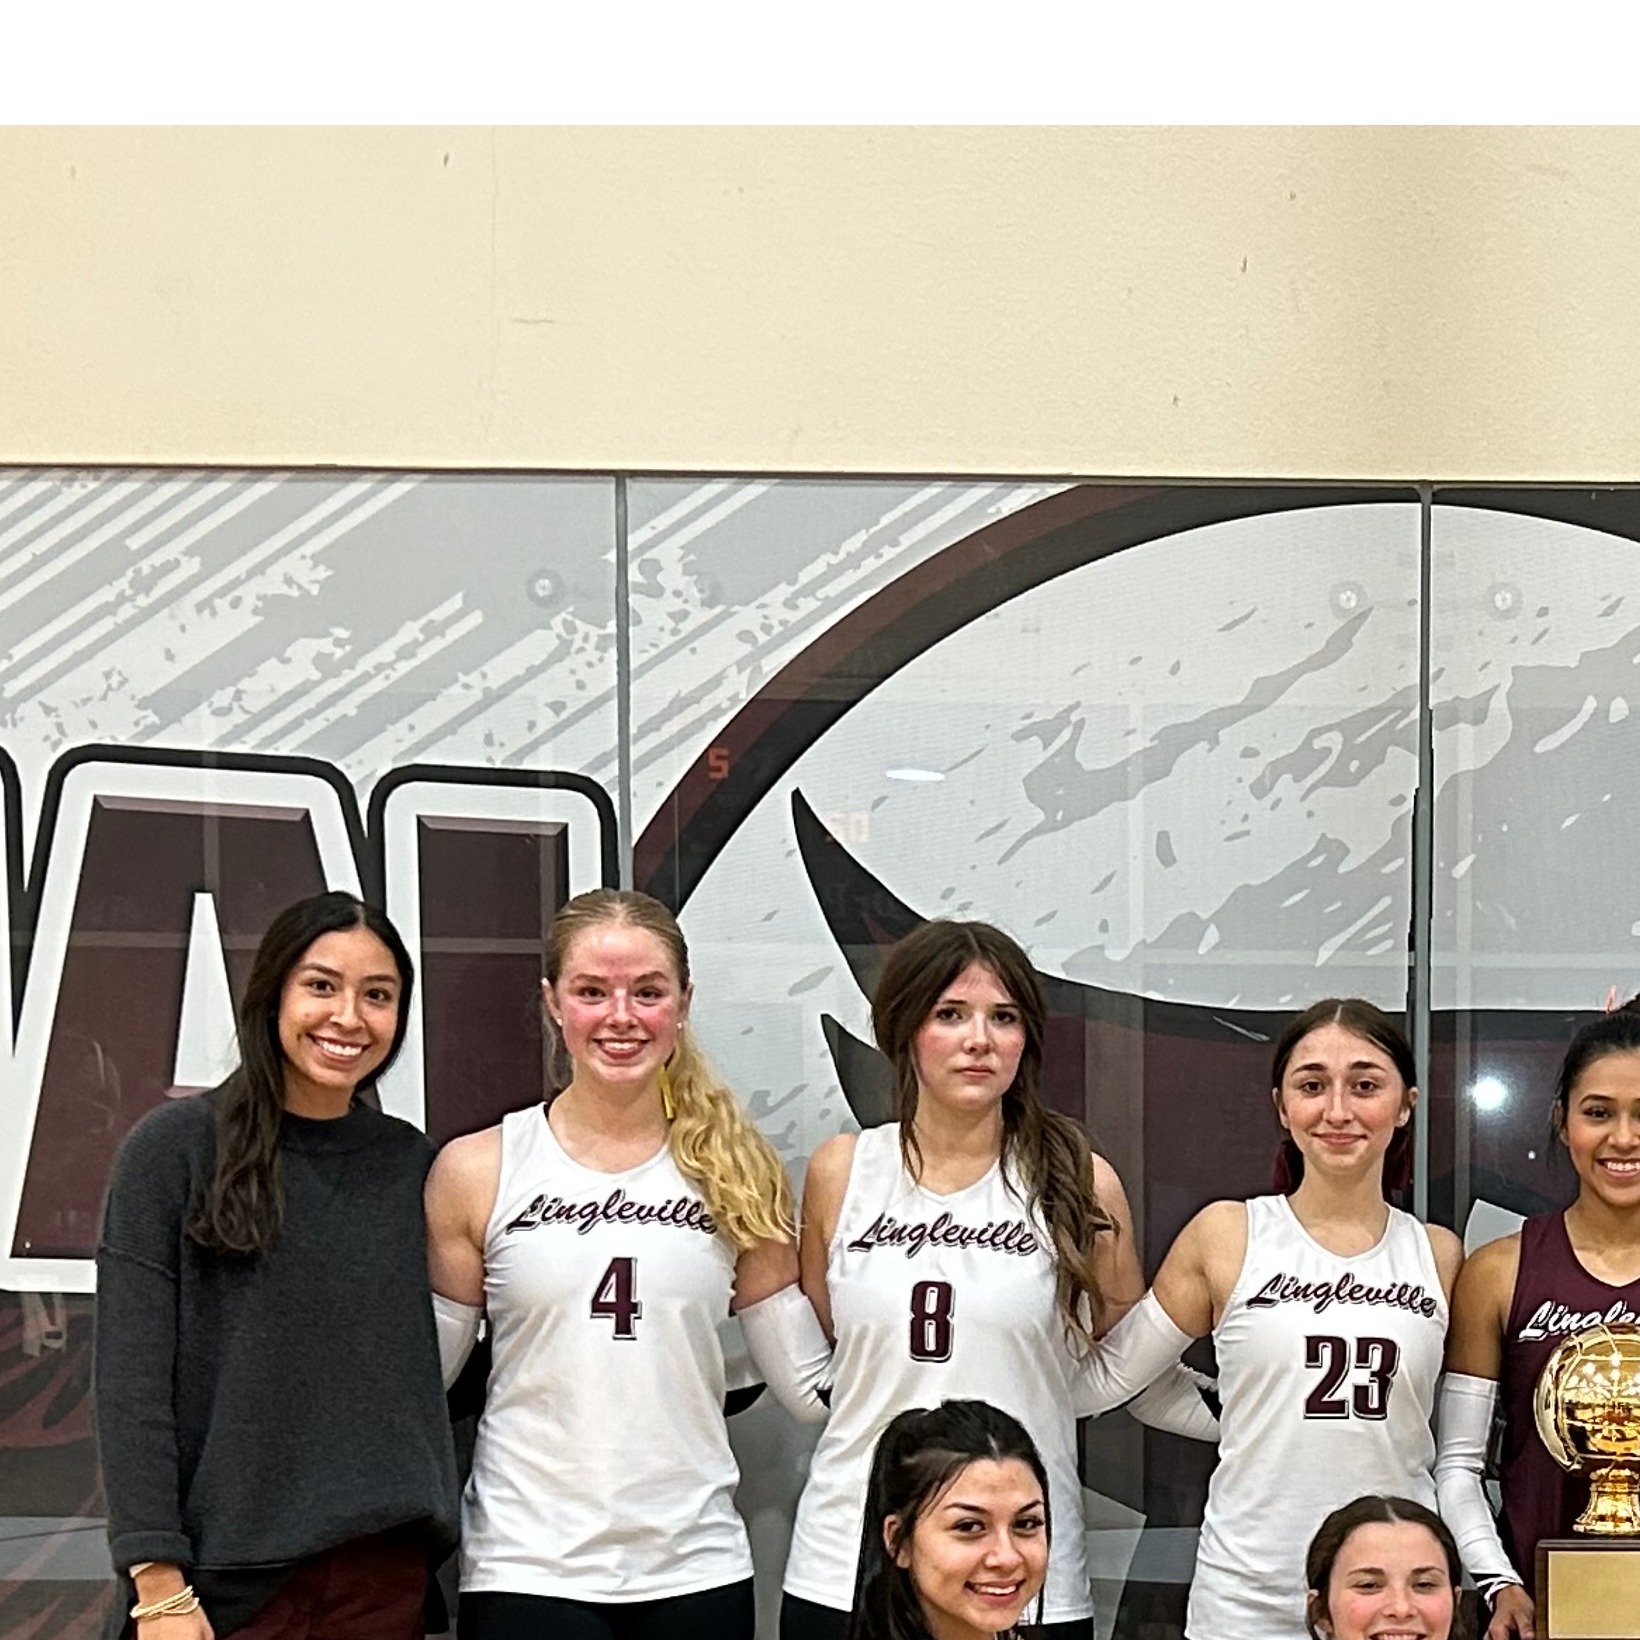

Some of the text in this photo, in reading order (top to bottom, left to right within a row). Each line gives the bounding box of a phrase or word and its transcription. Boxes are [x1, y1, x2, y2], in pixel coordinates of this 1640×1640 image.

[505, 1188, 718, 1235] Lingleville
[847, 1212, 1038, 1258] Lingleville
[590, 1257, 643, 1341] 4
[909, 1280, 956, 1363] 8
[1246, 1273, 1437, 1319] Lingleville
[1303, 1334, 1399, 1420] 23
